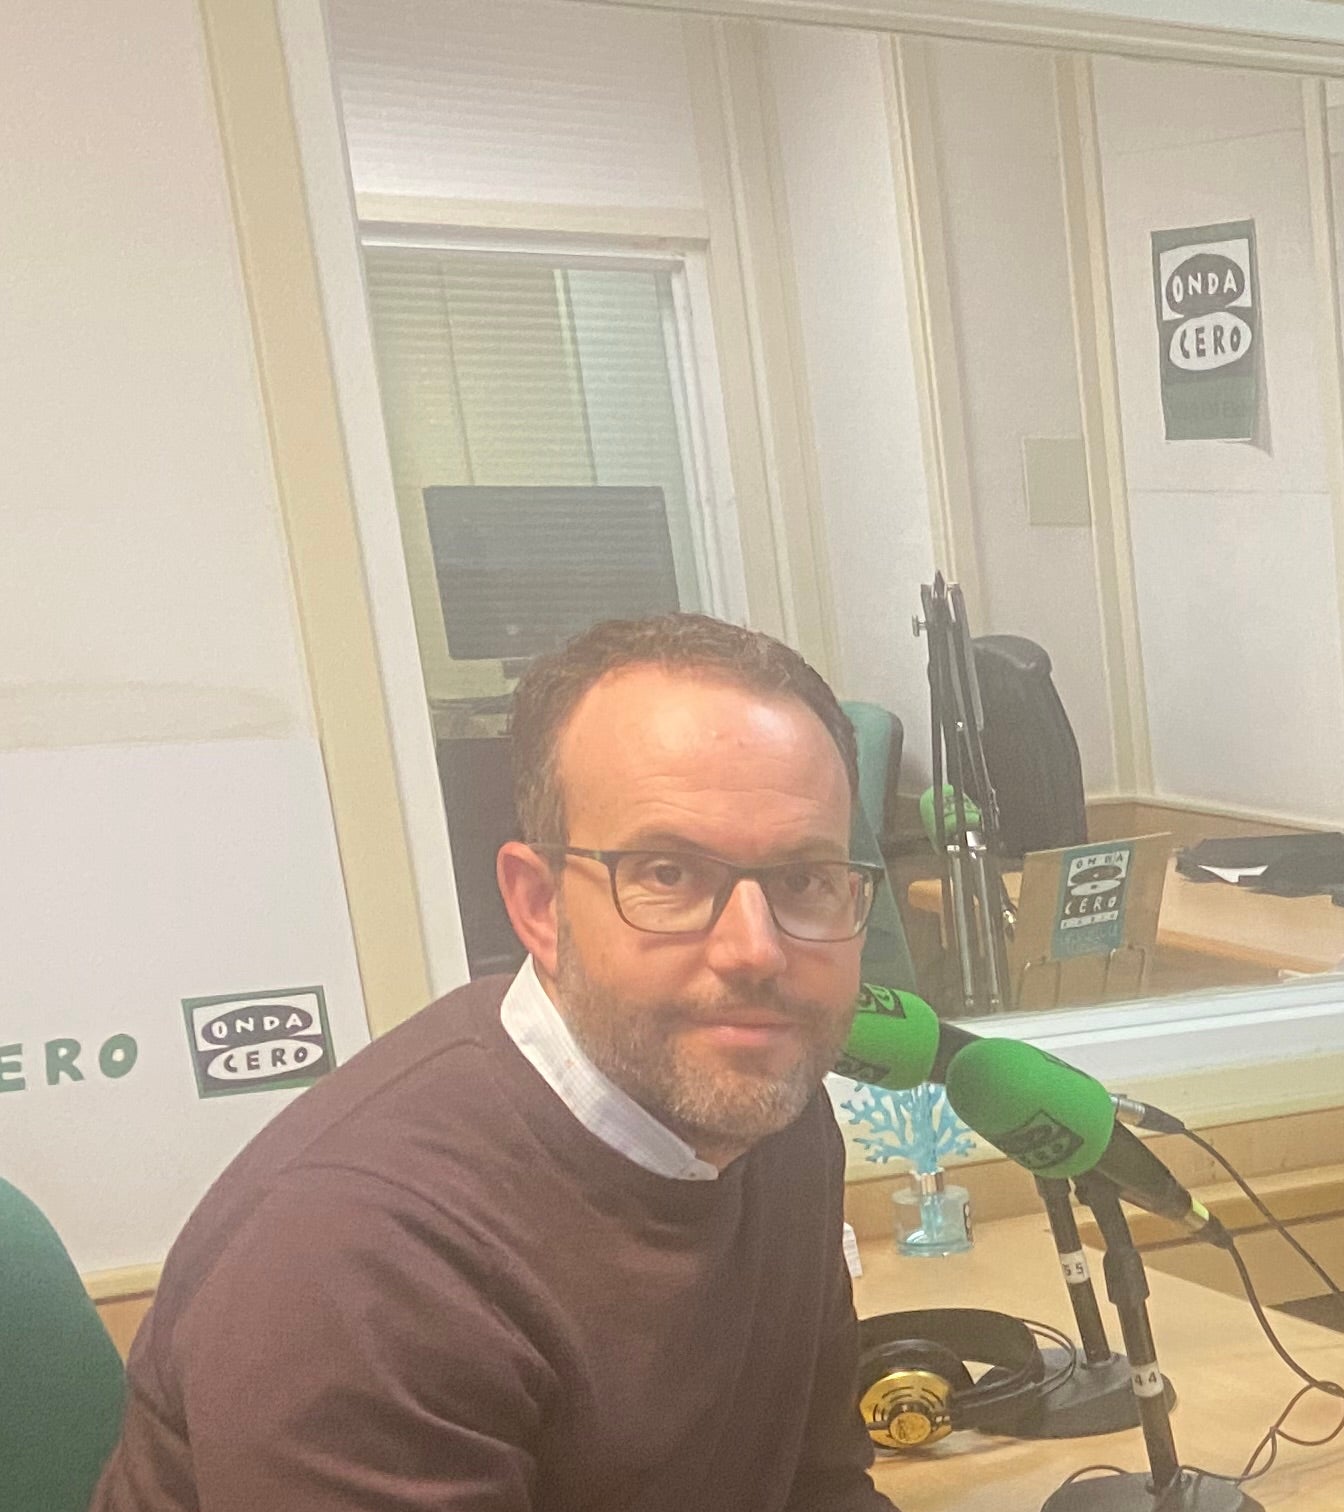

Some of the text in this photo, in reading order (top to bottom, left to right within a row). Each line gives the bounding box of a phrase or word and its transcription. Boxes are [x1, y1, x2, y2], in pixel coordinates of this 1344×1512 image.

[1171, 268, 1238, 304] ONDA
[1179, 324, 1242, 360] CERO
[1064, 895, 1118, 915] CERO
[211, 1012, 303, 1039] ONDA
[223, 1046, 309, 1073] CERO
